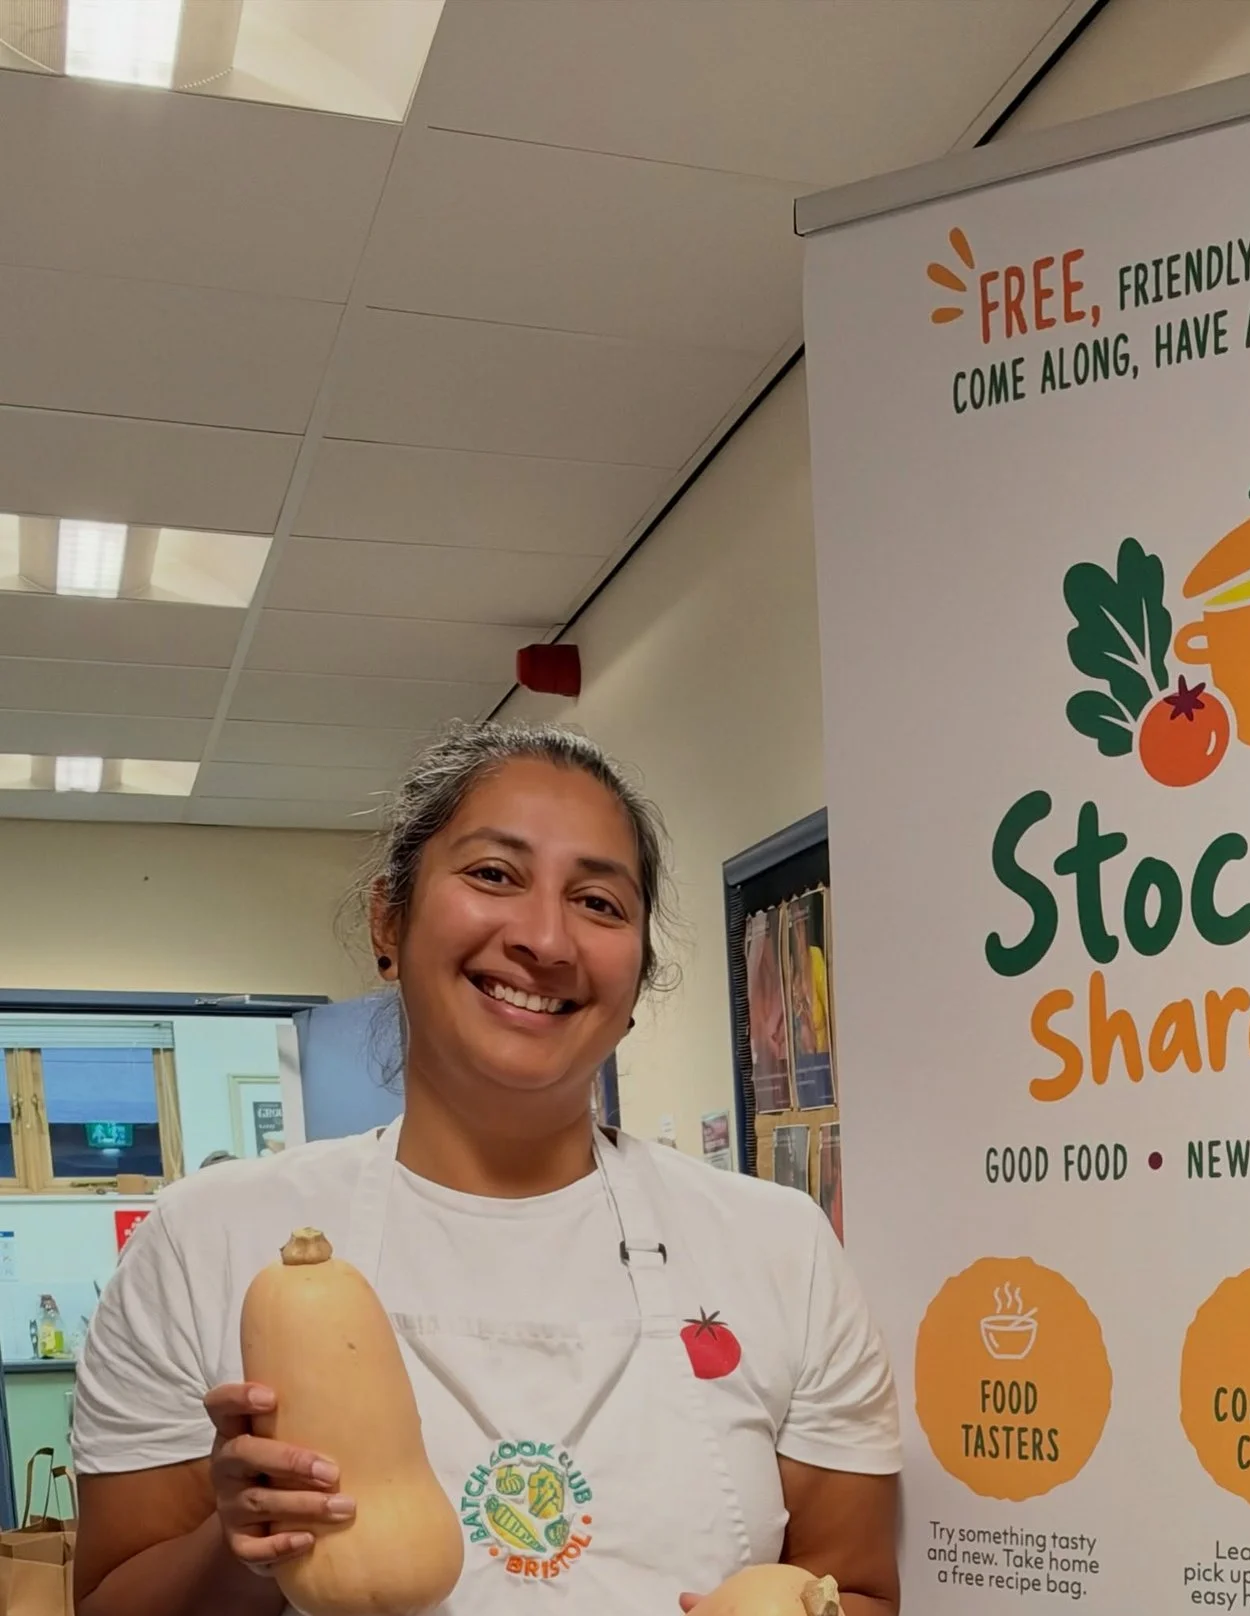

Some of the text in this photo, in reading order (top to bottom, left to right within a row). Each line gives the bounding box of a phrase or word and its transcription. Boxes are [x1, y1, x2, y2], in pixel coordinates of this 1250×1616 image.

[980, 249, 1100, 344] FREE,
[953, 357, 1026, 414] COME
[1041, 333, 1139, 394] ALONG,
[1155, 309, 1228, 368] HAVE
[986, 1146, 1048, 1183] GOOD
[1064, 1143, 1127, 1182] FOOD
[1188, 1139, 1250, 1180] NEW
[981, 1380, 1037, 1415] FOOD
[961, 1424, 1060, 1462] TASTERS
[461, 1463, 492, 1543] BATCH
[489, 1440, 555, 1467] COOK
[506, 1533, 593, 1579] BRISTOL
[929, 1521, 1097, 1556] Try something tasty
[927, 1543, 1099, 1574] and new. Take home
[1184, 1562, 1224, 1586] pick
[938, 1565, 1086, 1600] a free recipe bag.
[1191, 1590, 1237, 1611] easy
